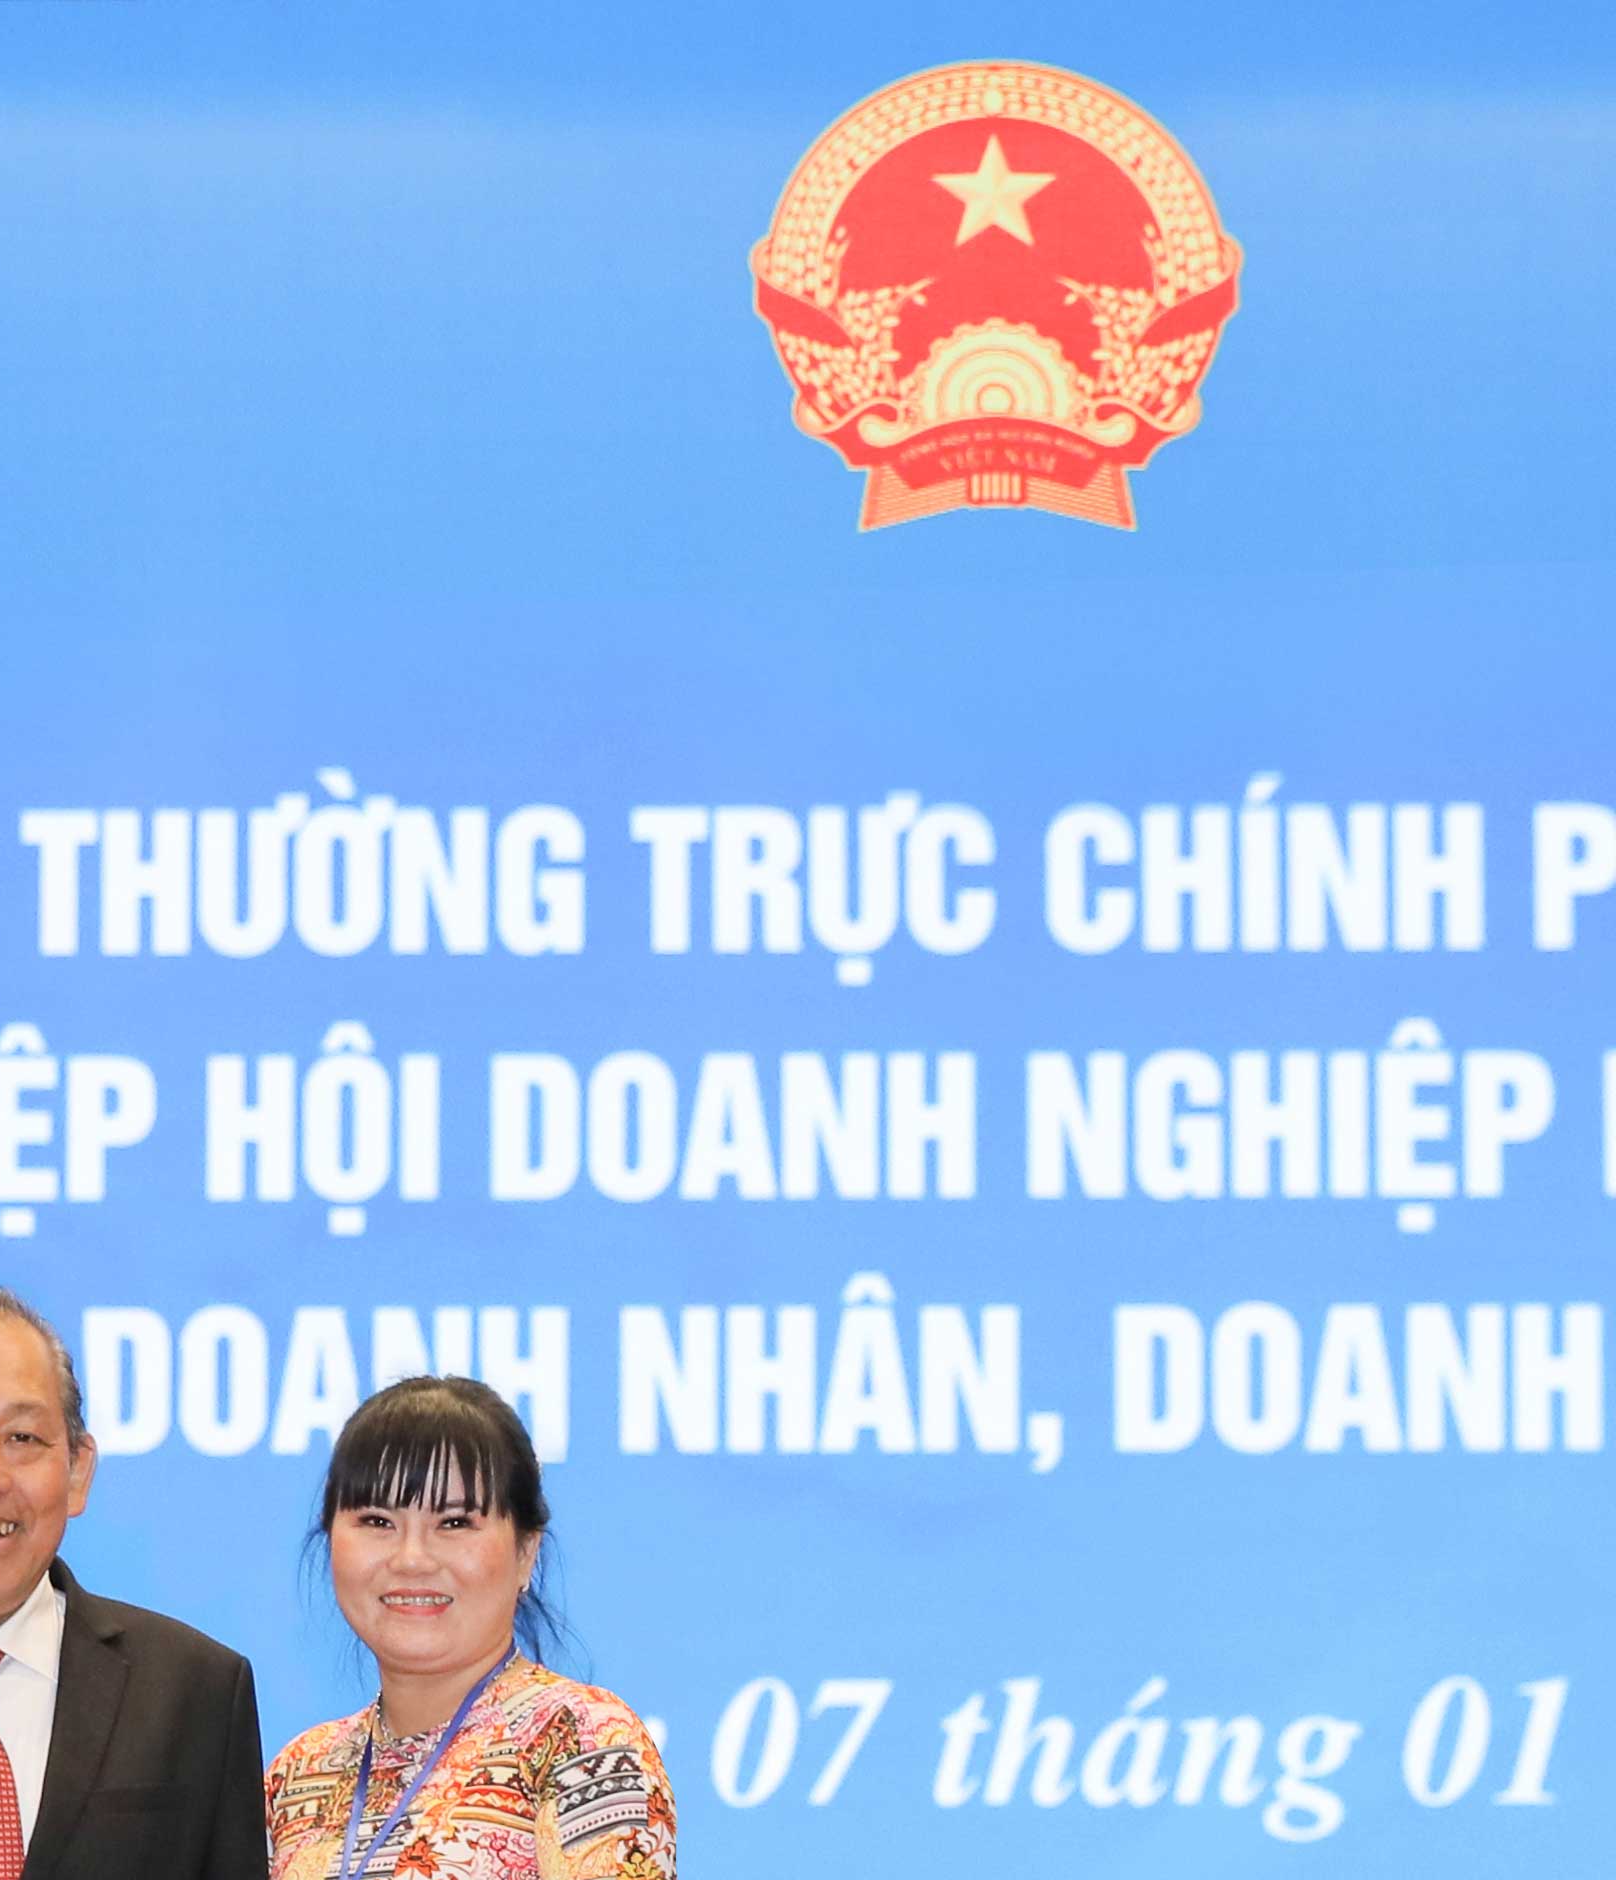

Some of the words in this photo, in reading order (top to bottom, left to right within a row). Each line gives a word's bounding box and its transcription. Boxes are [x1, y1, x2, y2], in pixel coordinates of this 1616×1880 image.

[21, 770, 584, 956] THƯỜNG
[632, 794, 995, 985] TRỰC
[1046, 777, 1483, 953] CHÍNH
[207, 1023, 439, 1234] HỘI
[491, 1052, 975, 1201] DOANH
[1028, 1019, 1553, 1232] NGHIỆP
[82, 1304, 569, 1463] DOANH
[620, 1274, 1062, 1472] NHÂN,
[1115, 1302, 1603, 1453] DOANH
[712, 1678, 891, 1807] 07
[934, 1679, 1360, 1841] tháng
[1404, 1677, 1566, 1806] 01
